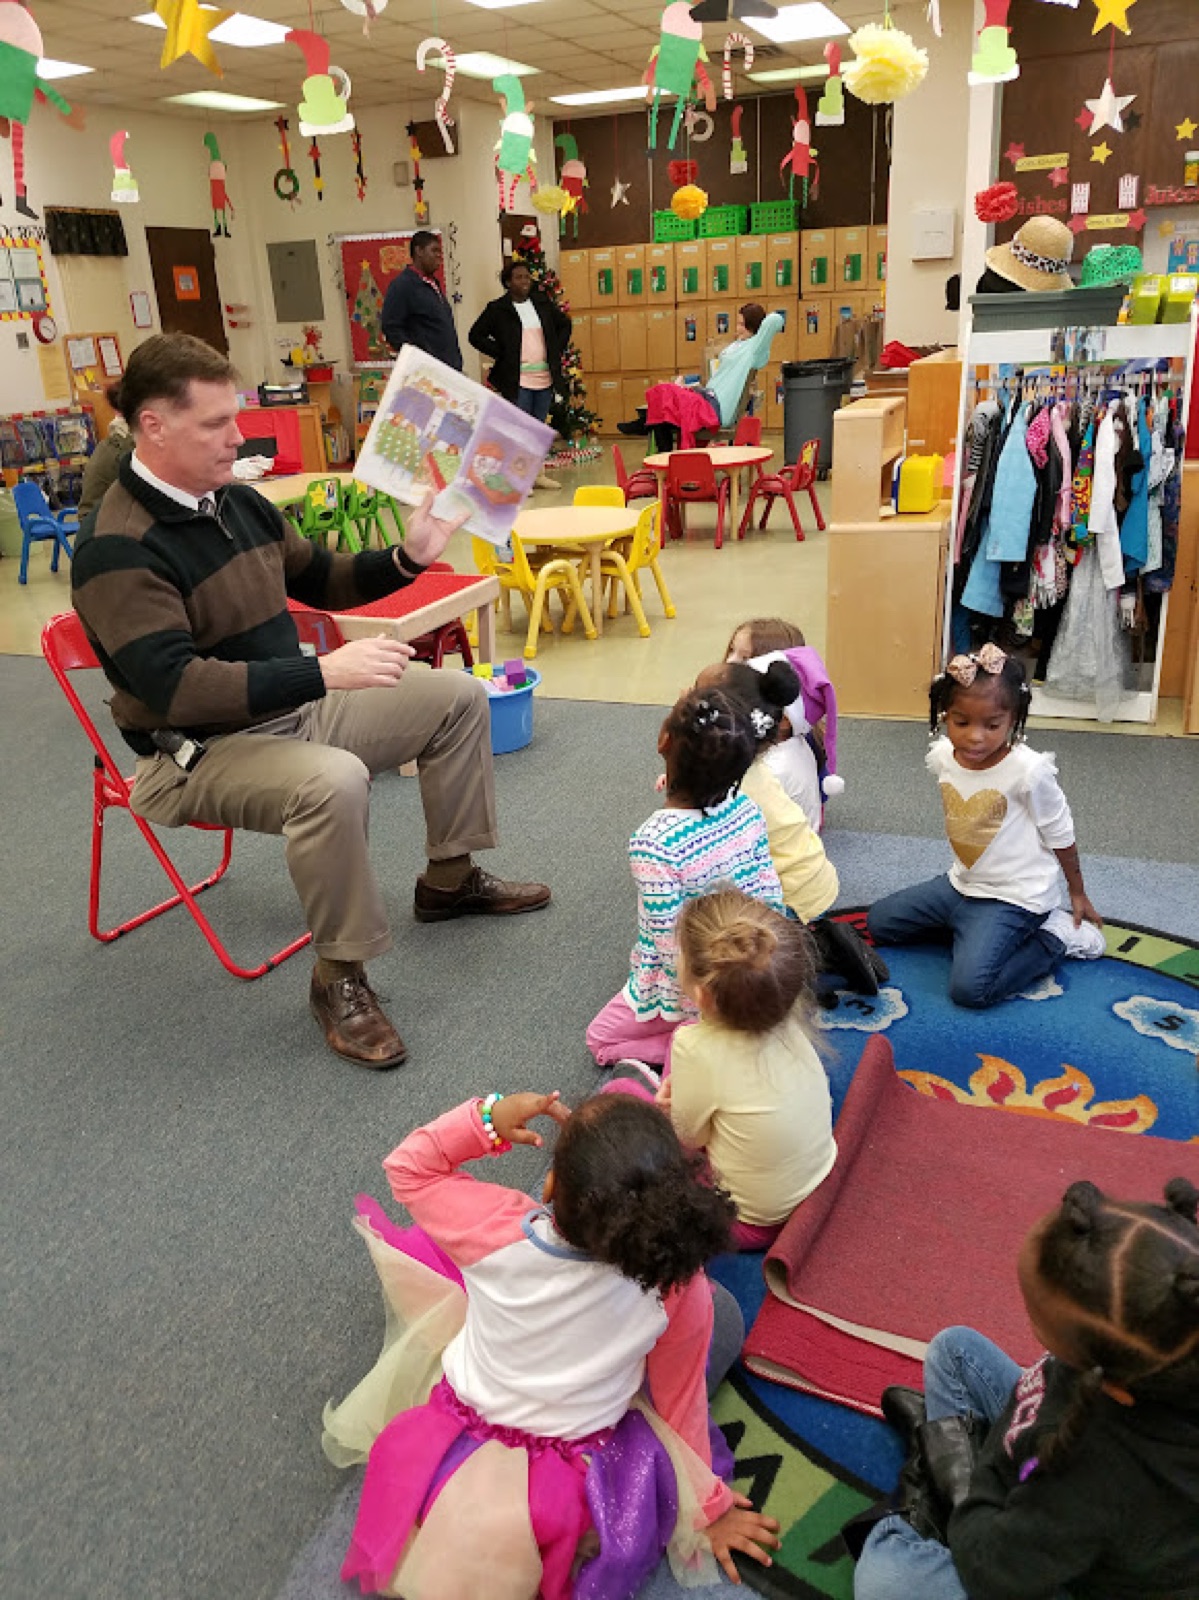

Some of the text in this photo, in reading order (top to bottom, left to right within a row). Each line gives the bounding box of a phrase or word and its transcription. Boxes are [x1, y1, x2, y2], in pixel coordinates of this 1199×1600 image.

[311, 621, 330, 653] 1
[845, 998, 876, 1016] 3
[1152, 1014, 1187, 1031] 5
